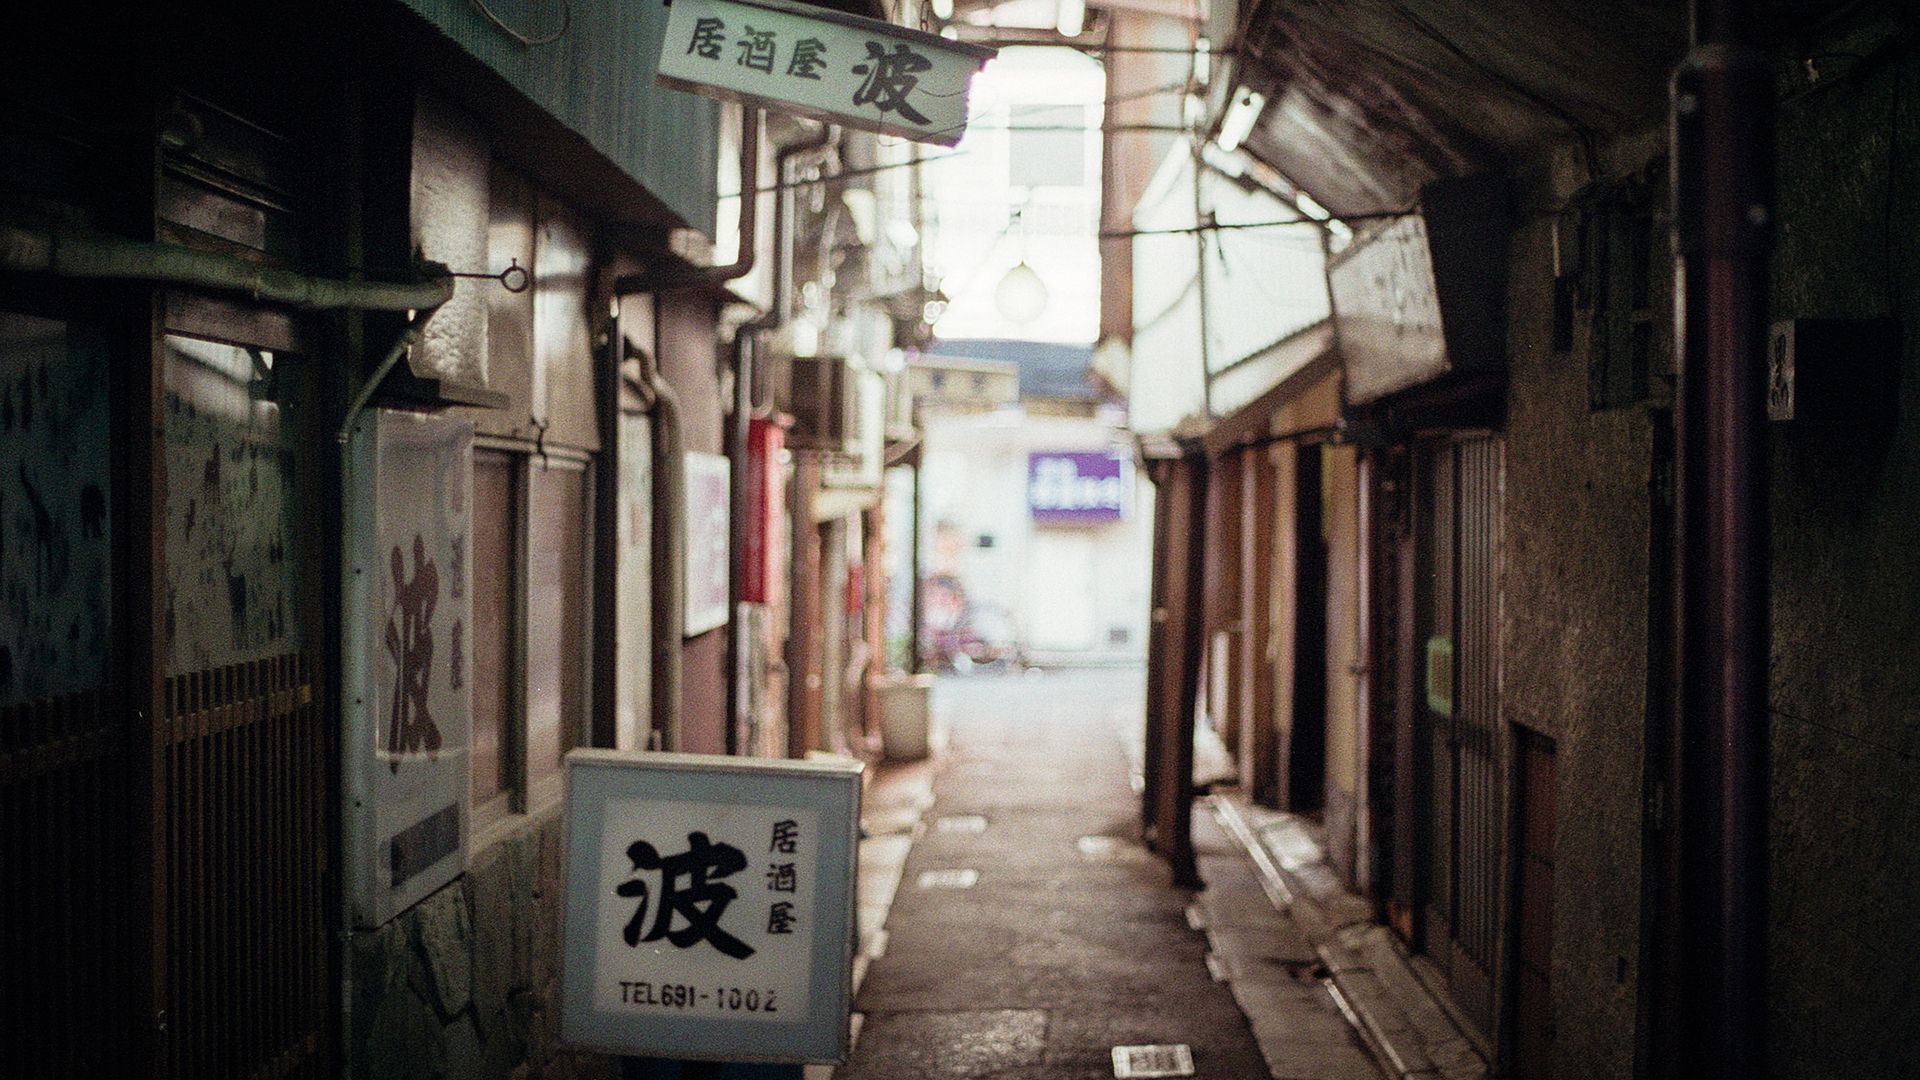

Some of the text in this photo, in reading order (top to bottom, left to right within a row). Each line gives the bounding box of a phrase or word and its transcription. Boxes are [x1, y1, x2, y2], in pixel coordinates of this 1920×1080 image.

[686, 17, 932, 125] 居酒屋 波
[450, 450, 464, 691] 酒屋
[385, 534, 441, 775] 波
[616, 831, 757, 961] 波
[765, 819, 799, 934] 居酒屋
